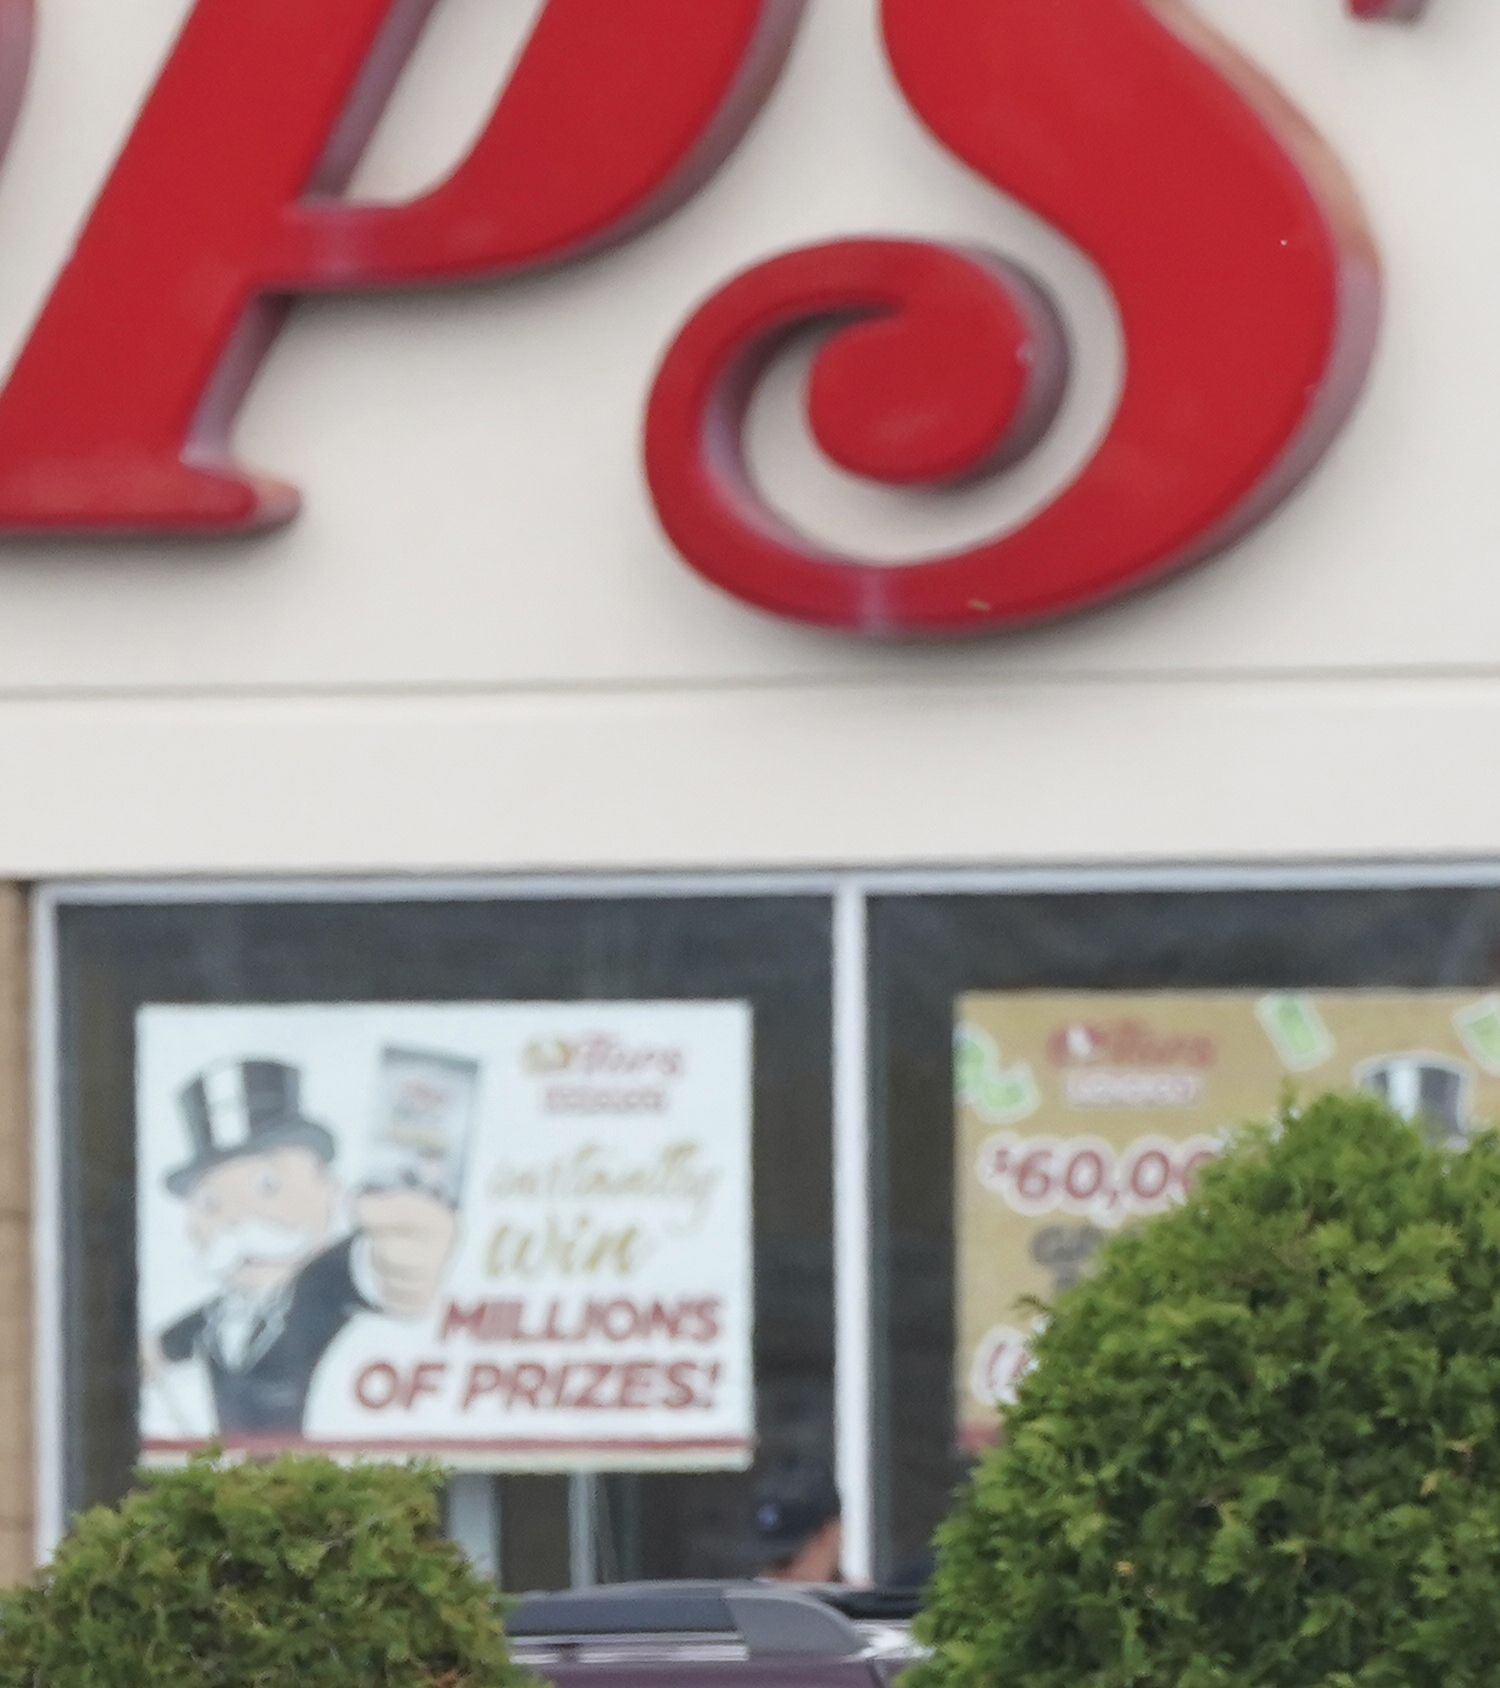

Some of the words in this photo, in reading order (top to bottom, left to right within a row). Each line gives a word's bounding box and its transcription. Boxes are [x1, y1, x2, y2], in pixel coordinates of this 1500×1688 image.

[437, 1294, 723, 1344] MILLIONS
[354, 1361, 448, 1414] OF
[461, 1360, 723, 1414] PRIZES!
